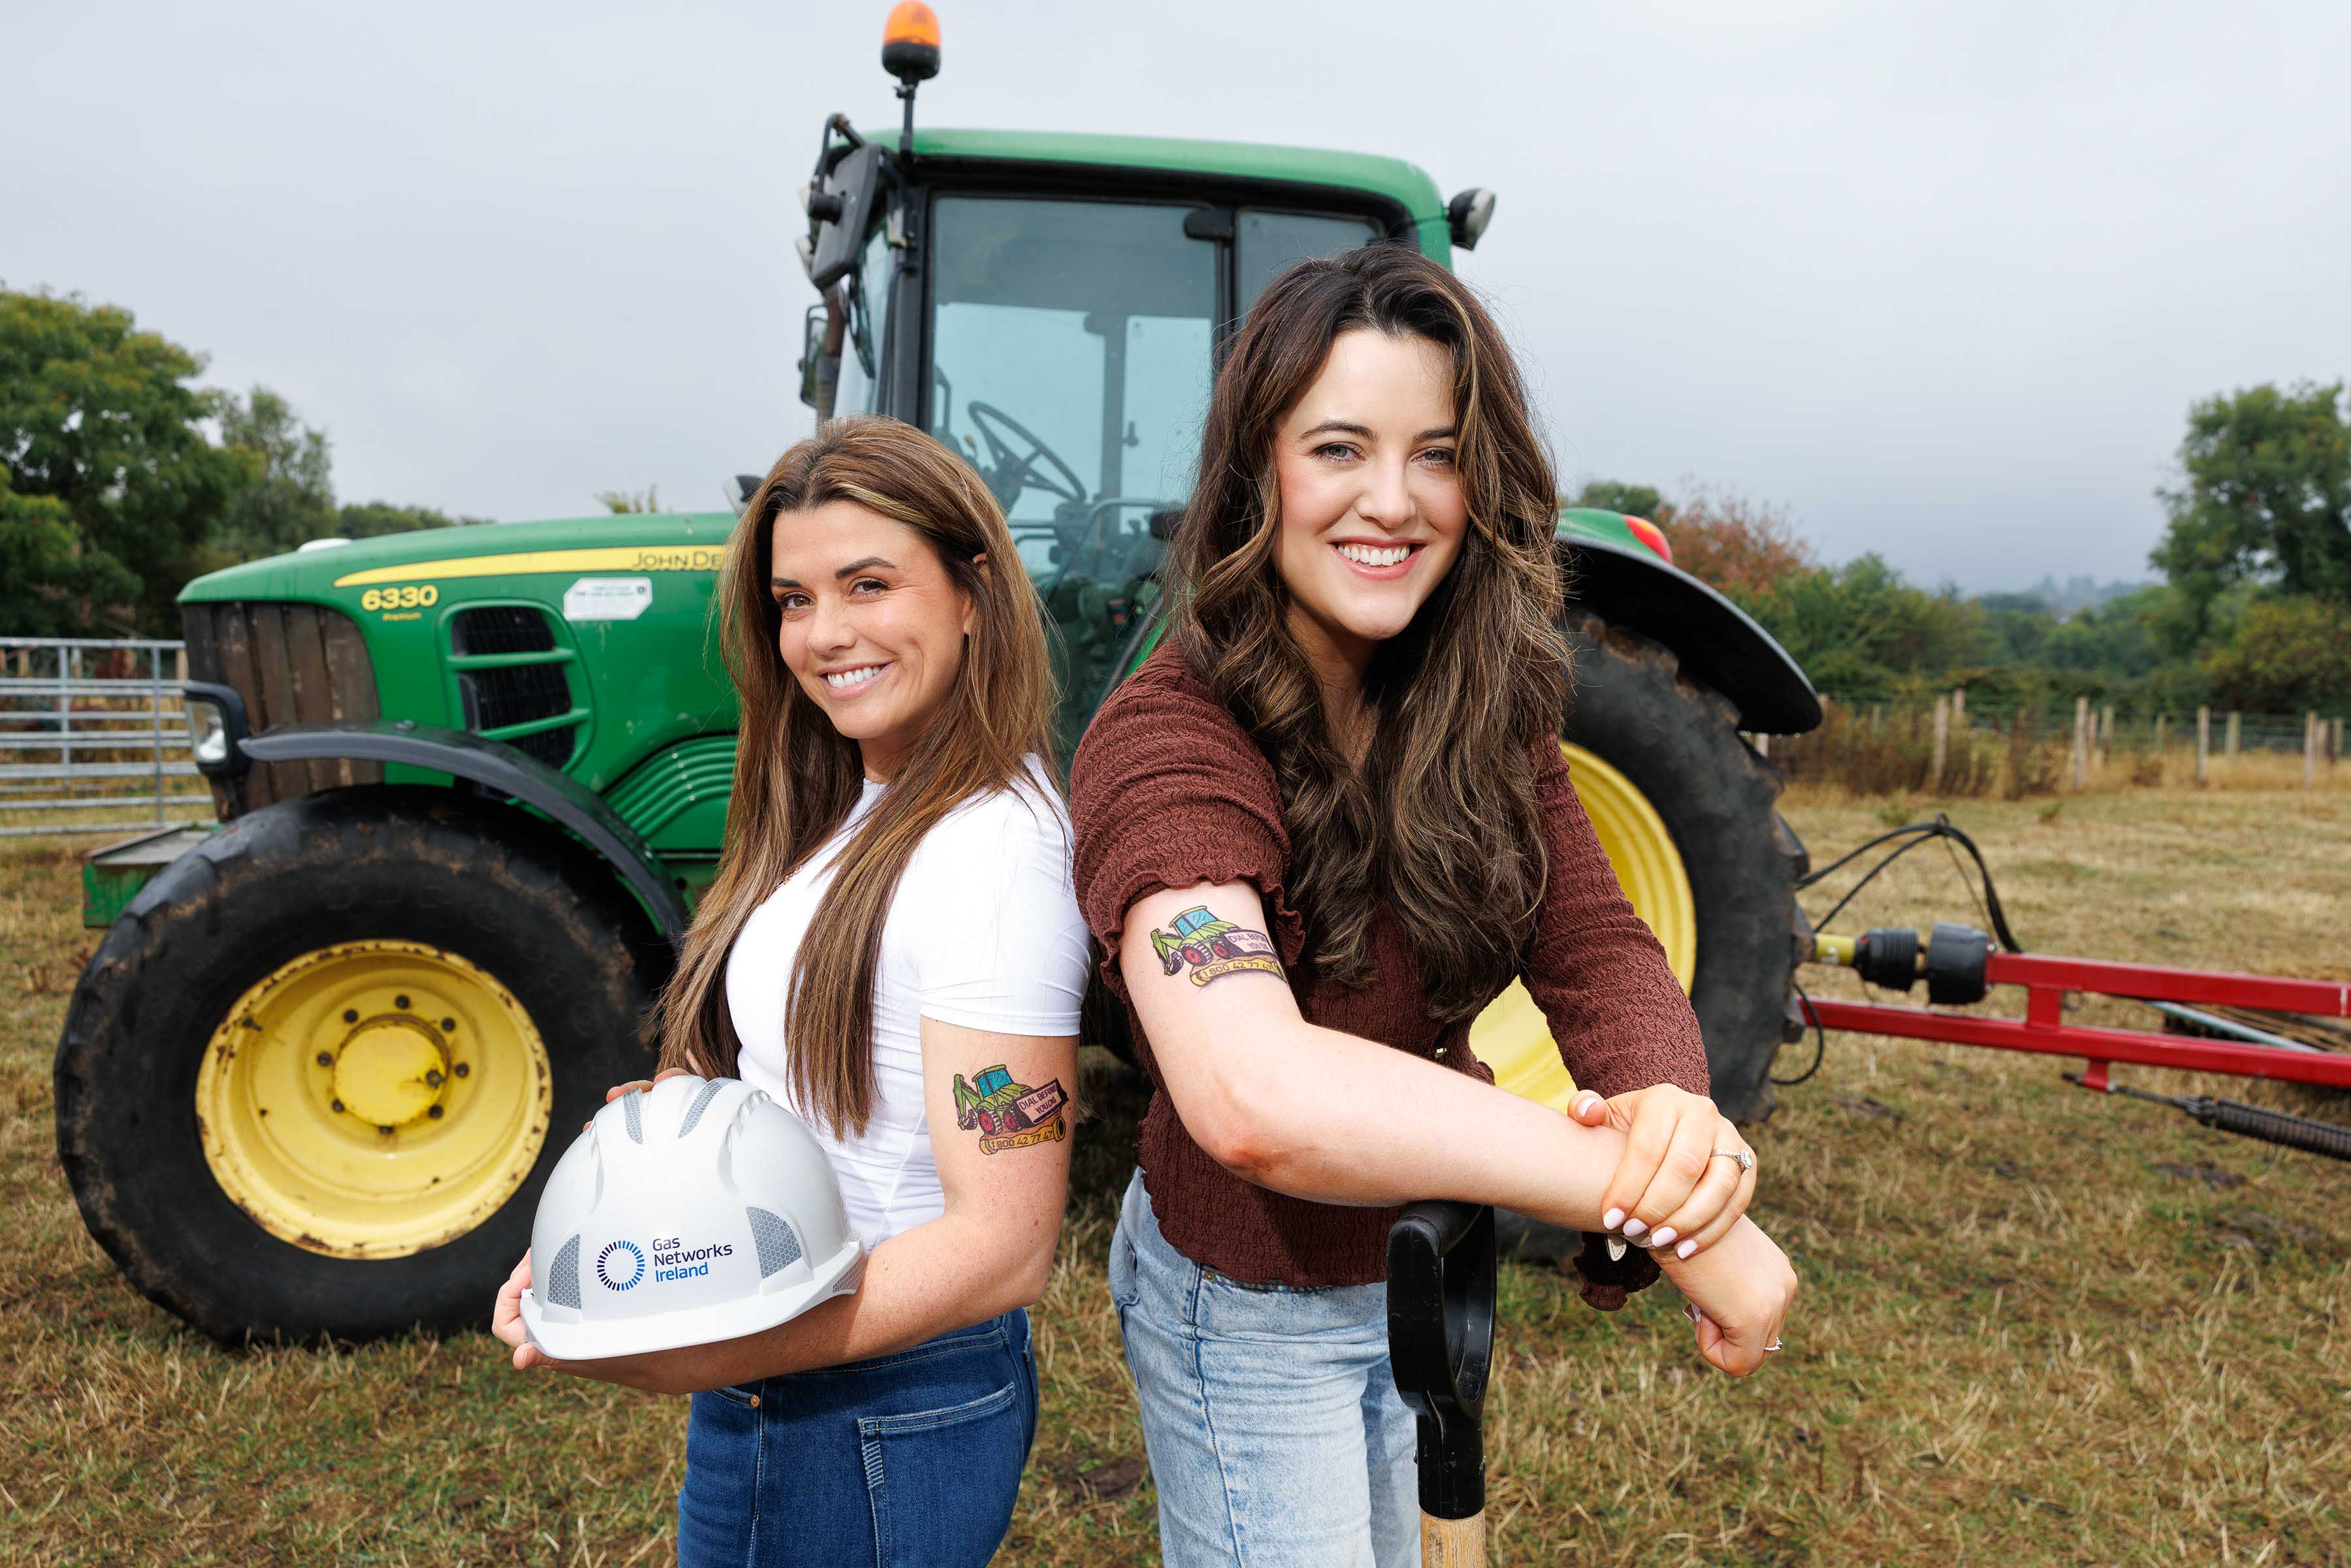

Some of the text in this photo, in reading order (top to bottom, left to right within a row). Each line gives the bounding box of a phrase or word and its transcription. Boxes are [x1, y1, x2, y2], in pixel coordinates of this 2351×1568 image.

[632, 552, 688, 568] JOHN
[360, 584, 439, 611] 6330
[1209, 965, 1230, 974] 800
[1019, 1085, 1057, 1110] DIAL BEFORE
[1035, 1102, 1049, 1114] YOU
[997, 1139, 1014, 1148] 800
[1017, 1137, 1029, 1145] 42
[1031, 1134, 1041, 1144] 77
[1043, 1130, 1053, 1140] 47
[652, 1238, 680, 1251] Gas
[654, 1244, 733, 1266] Networks
[656, 1262, 709, 1282] Ireland
